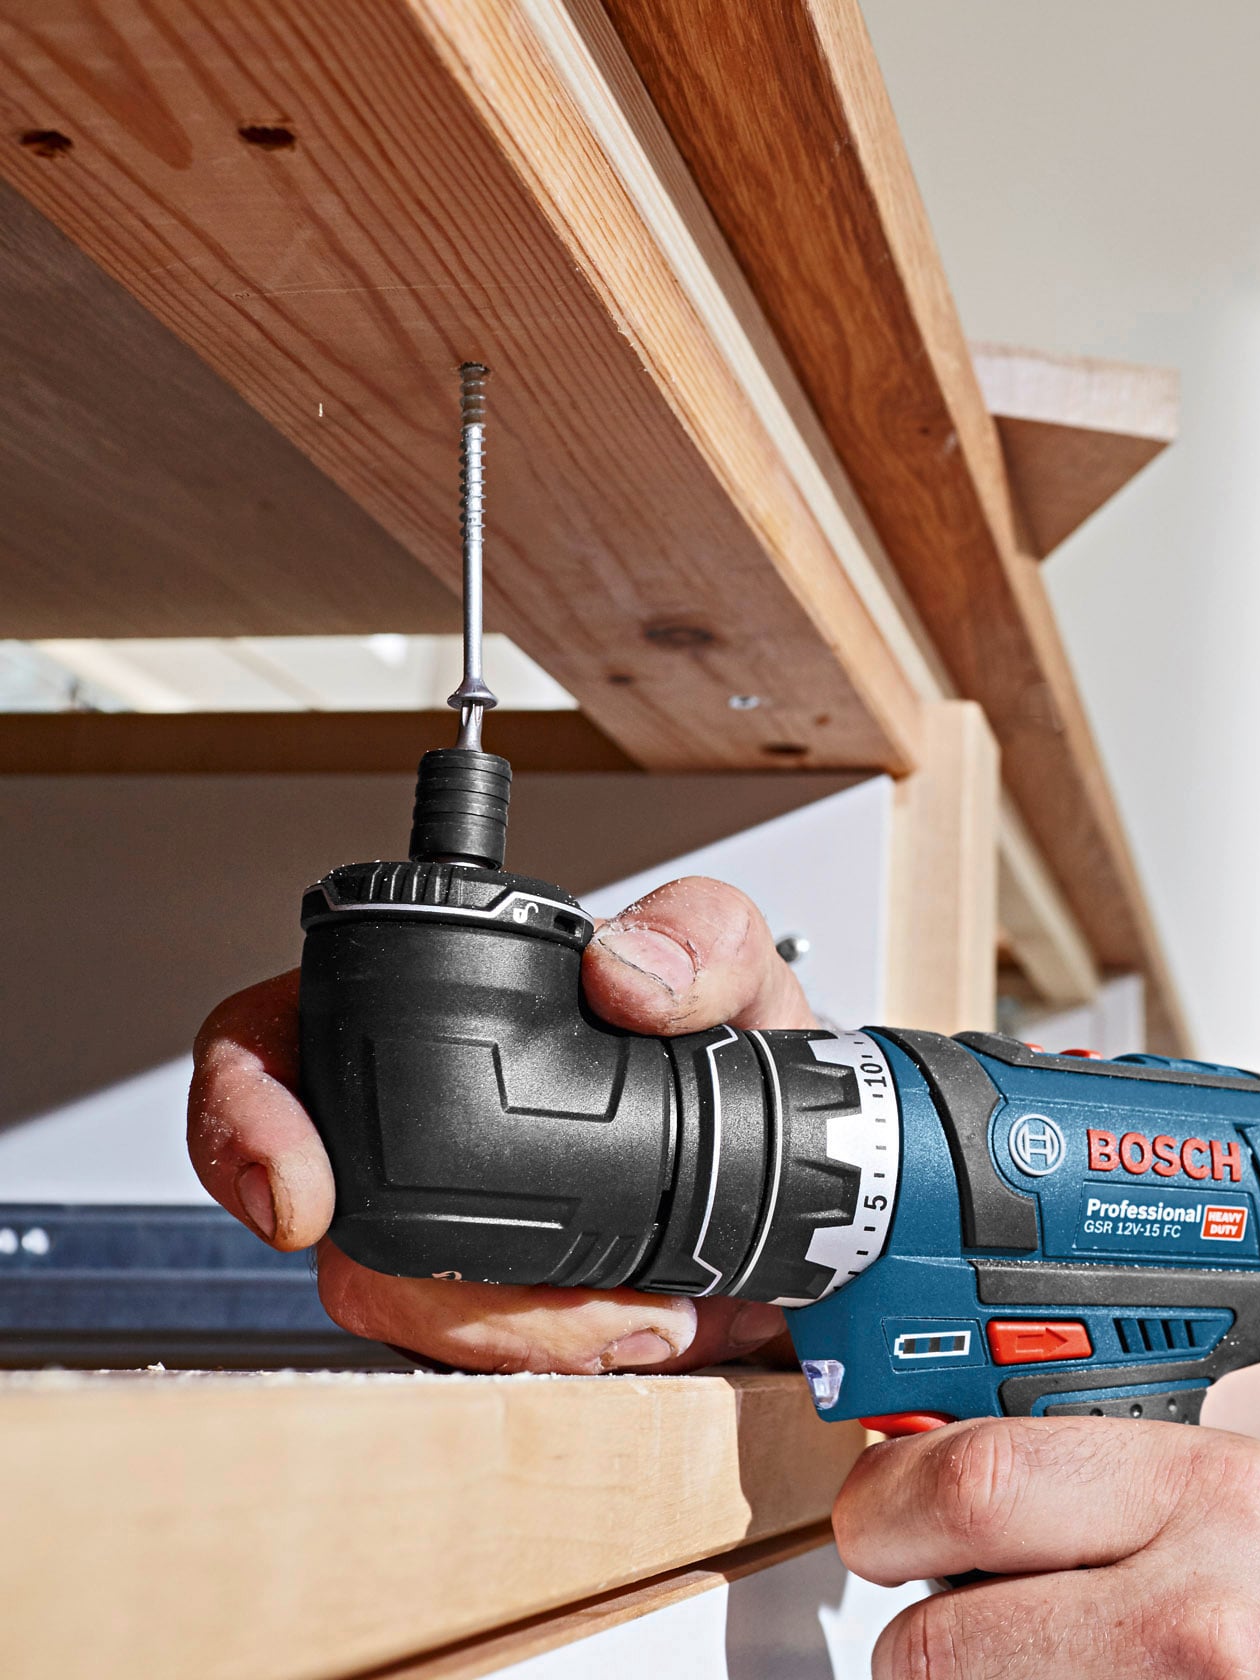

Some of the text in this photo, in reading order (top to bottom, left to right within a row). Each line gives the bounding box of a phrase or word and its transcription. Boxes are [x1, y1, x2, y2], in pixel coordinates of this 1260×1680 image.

[860, 1063, 887, 1087] 10
[1086, 1129, 1242, 1182] BOSCH
[863, 1195, 888, 1211] 5
[1086, 1198, 1202, 1223] Professional
[1207, 1211, 1242, 1224] HEAVY
[1084, 1219, 1182, 1238] GSR 12V-15 FC
[1209, 1224, 1239, 1236] DUTY
